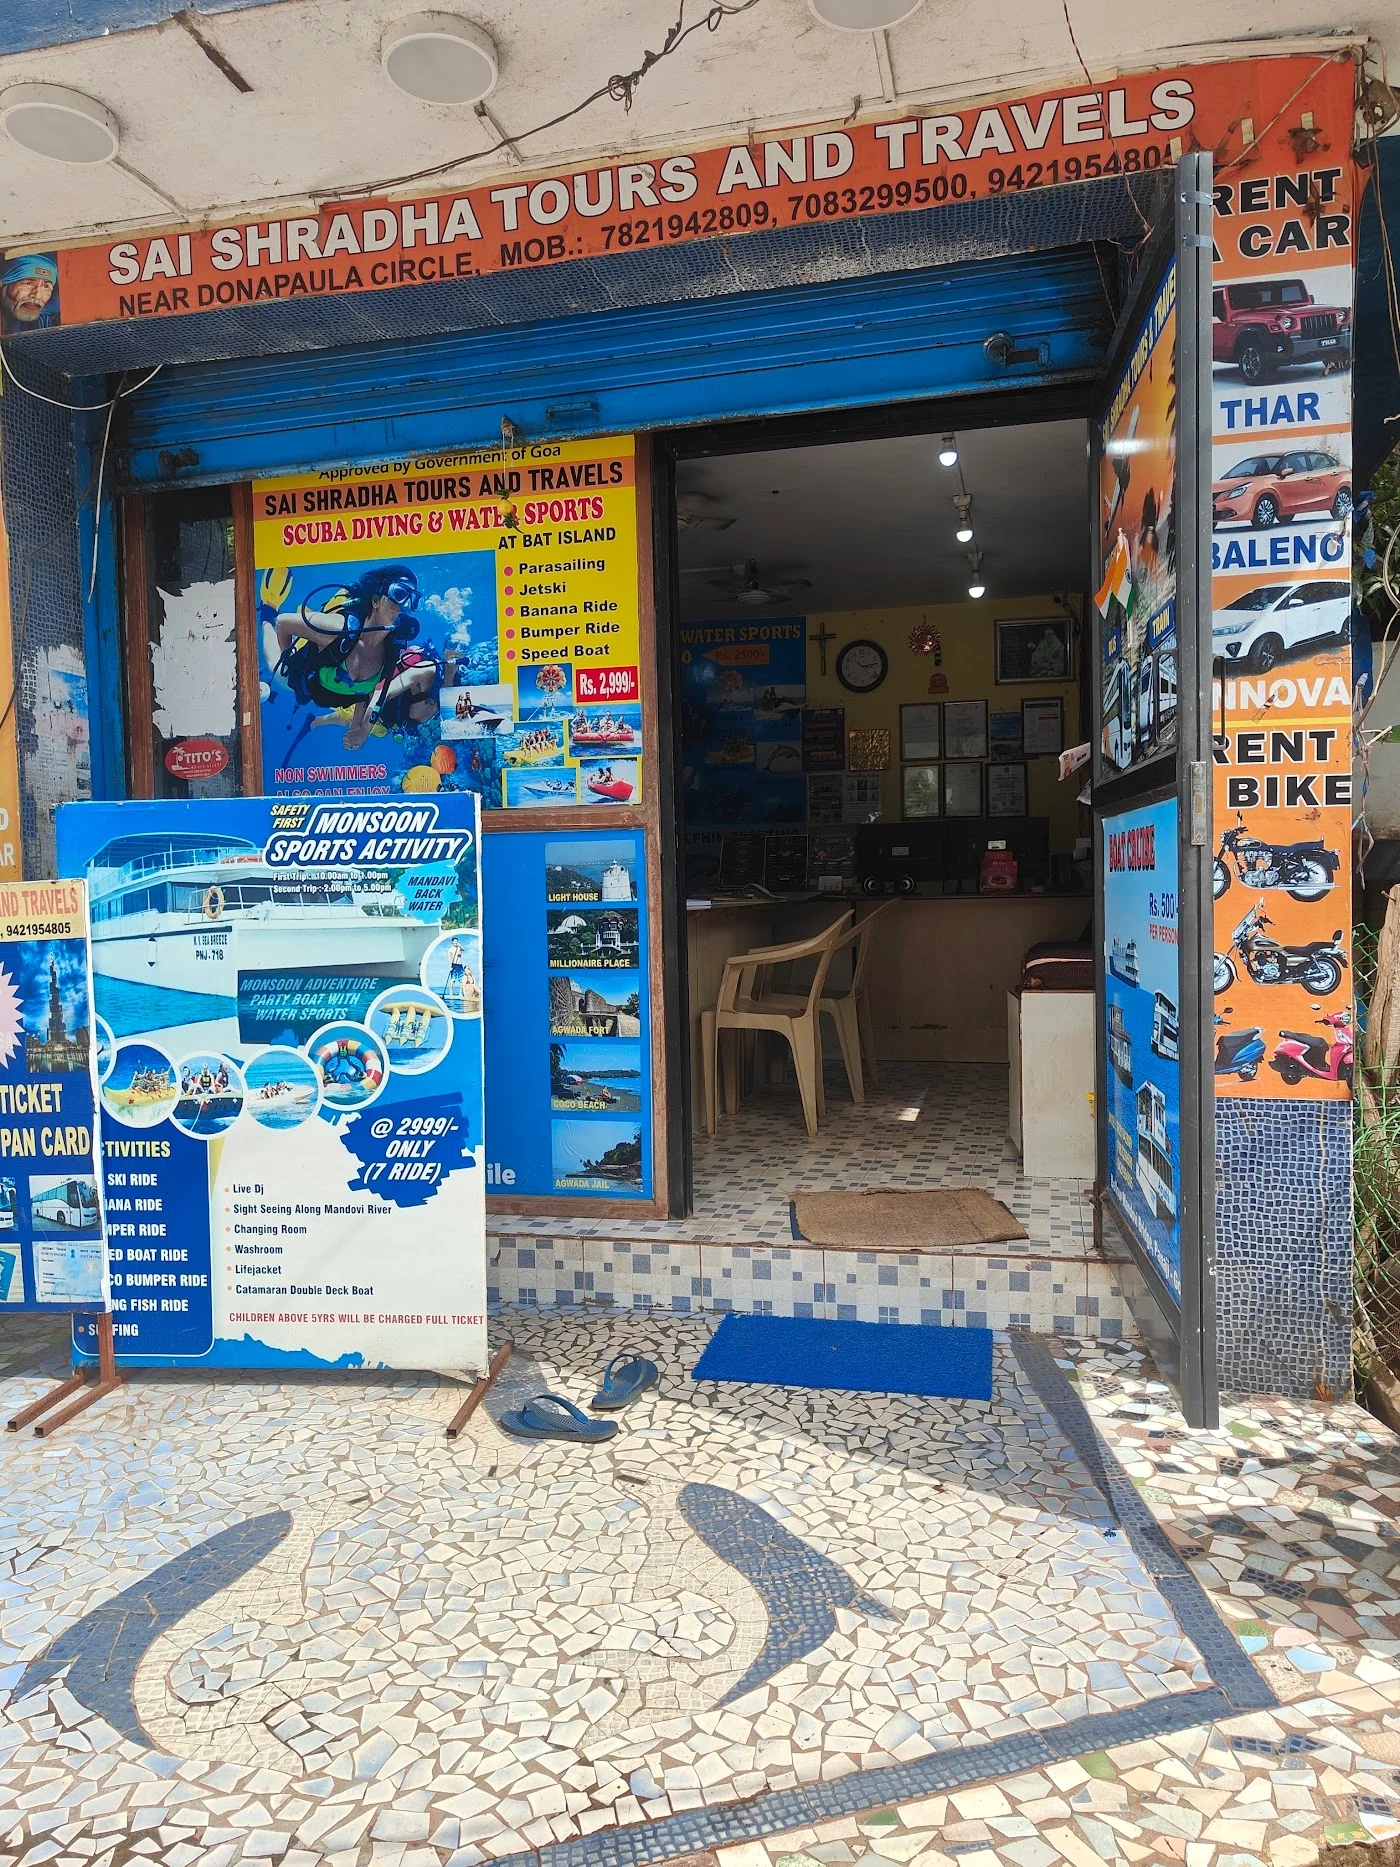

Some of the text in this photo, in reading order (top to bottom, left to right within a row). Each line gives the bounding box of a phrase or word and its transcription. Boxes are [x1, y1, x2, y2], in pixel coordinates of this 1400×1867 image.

[108, 79, 1197, 286] SAI SHRADHA TOURS AND TRAVELS
[1212, 168, 1342, 218] RENT
[1239, 214, 1351, 259] CAR
[118, 286, 190, 317] NEAR
[200, 265, 359, 308] DONAPAULA
[369, 252, 480, 286] CIRCLE,
[600, 200, 778, 249] 7821942809,
[788, 172, 977, 221] 7083299500,
[1220, 392, 1320, 429] THAR
[393, 461, 411, 475] by
[415, 450, 508, 470] Government
[512, 447, 526, 461] of
[531, 445, 561, 458] Goa
[265, 461, 623, 516] SAI SHRADHA TOURS AND TRAVELS
[283, 519, 348, 547] SCUBA
[352, 512, 423, 540] DIVING
[428, 510, 443, 533] &
[524, 496, 604, 526] SPORTS
[498, 527, 616, 550] AT BAT ISLAND
[519, 558, 605, 575] Parasailing
[519, 581, 566, 596] Jetski
[520, 600, 618, 617] Banana Ride
[521, 621, 620, 639] Bumper Ride
[1152, 605, 1170, 640] TRAIN
[739, 624, 800, 641] SPORTS
[521, 643, 610, 661] Speed Boat
[579, 671, 635, 699] Rs. 2,999/-
[1212, 676, 1350, 710] NNOVA
[183, 749, 222, 764] TITO'S
[274, 763, 388, 784] NON SWIMMERS
[1228, 774, 1352, 808] BIKE
[270, 804, 310, 817] SAFETY
[272, 817, 305, 829] FIRST
[314, 811, 431, 834] MONSOON
[270, 838, 357, 862] SPORTS
[358, 837, 464, 861] ACTIVITY
[273, 871, 290, 881] First
[350, 871, 358, 880] to
[361, 871, 389, 881] 1.00pm
[408, 876, 456, 887] MANDAVI
[273, 883, 392, 894] Second Trip to 5.00pm
[414, 888, 442, 899] BACK
[22, 887, 78, 917] TRAVELS
[548, 892, 599, 902] LIGHT HOUSE
[1149, 892, 1160, 917] Rs.
[408, 901, 443, 911] WATER
[6, 922, 71, 937] 9421954805
[1149, 923, 1158, 940] PER
[210, 934, 228, 946] BREEZE
[550, 958, 630, 968] MILLIONAIRE PLACE
[240, 978, 379, 991] MONSOON ADVENTURE
[250, 992, 361, 1006] PARTY BOAT WITH
[255, 1008, 348, 1021] WATER SPORTS
[552, 1026, 610, 1035] AGWADA FORT
[0, 1083, 62, 1114] TICKET
[553, 1100, 606, 1110] COCO BEACH
[370, 1117, 460, 1139] @ 2999/-
[1, 1126, 90, 1158] PAN CARD
[385, 1140, 436, 1158] ONLY
[107, 1173, 158, 1187] SKI RIDE
[363, 1162, 442, 1184] (7 RIDE)
[233, 1183, 264, 1196] Live Dj
[555, 1178, 610, 1189] AGWADA JAIL
[135, 1198, 163, 1211] RIDE
[233, 1204, 392, 1216] Sight Seeing Along Mandovi River
[141, 1223, 167, 1237] RIDE
[234, 1224, 307, 1236] Changing Room
[127, 1248, 188, 1262] BOAT RIDE
[235, 1244, 283, 1255] Washroom
[235, 1264, 282, 1276] Lifejacket
[126, 1274, 208, 1287] BUMPER RIDE
[235, 1284, 374, 1296] Catamaran Double Deck Boat
[130, 1299, 188, 1312] FISH RIDE
[229, 1312, 484, 1326] CHILDREN ABOVE 5YRS WILL BE CHARGED FULL TICKET
[88, 1323, 139, 1336] SFING
